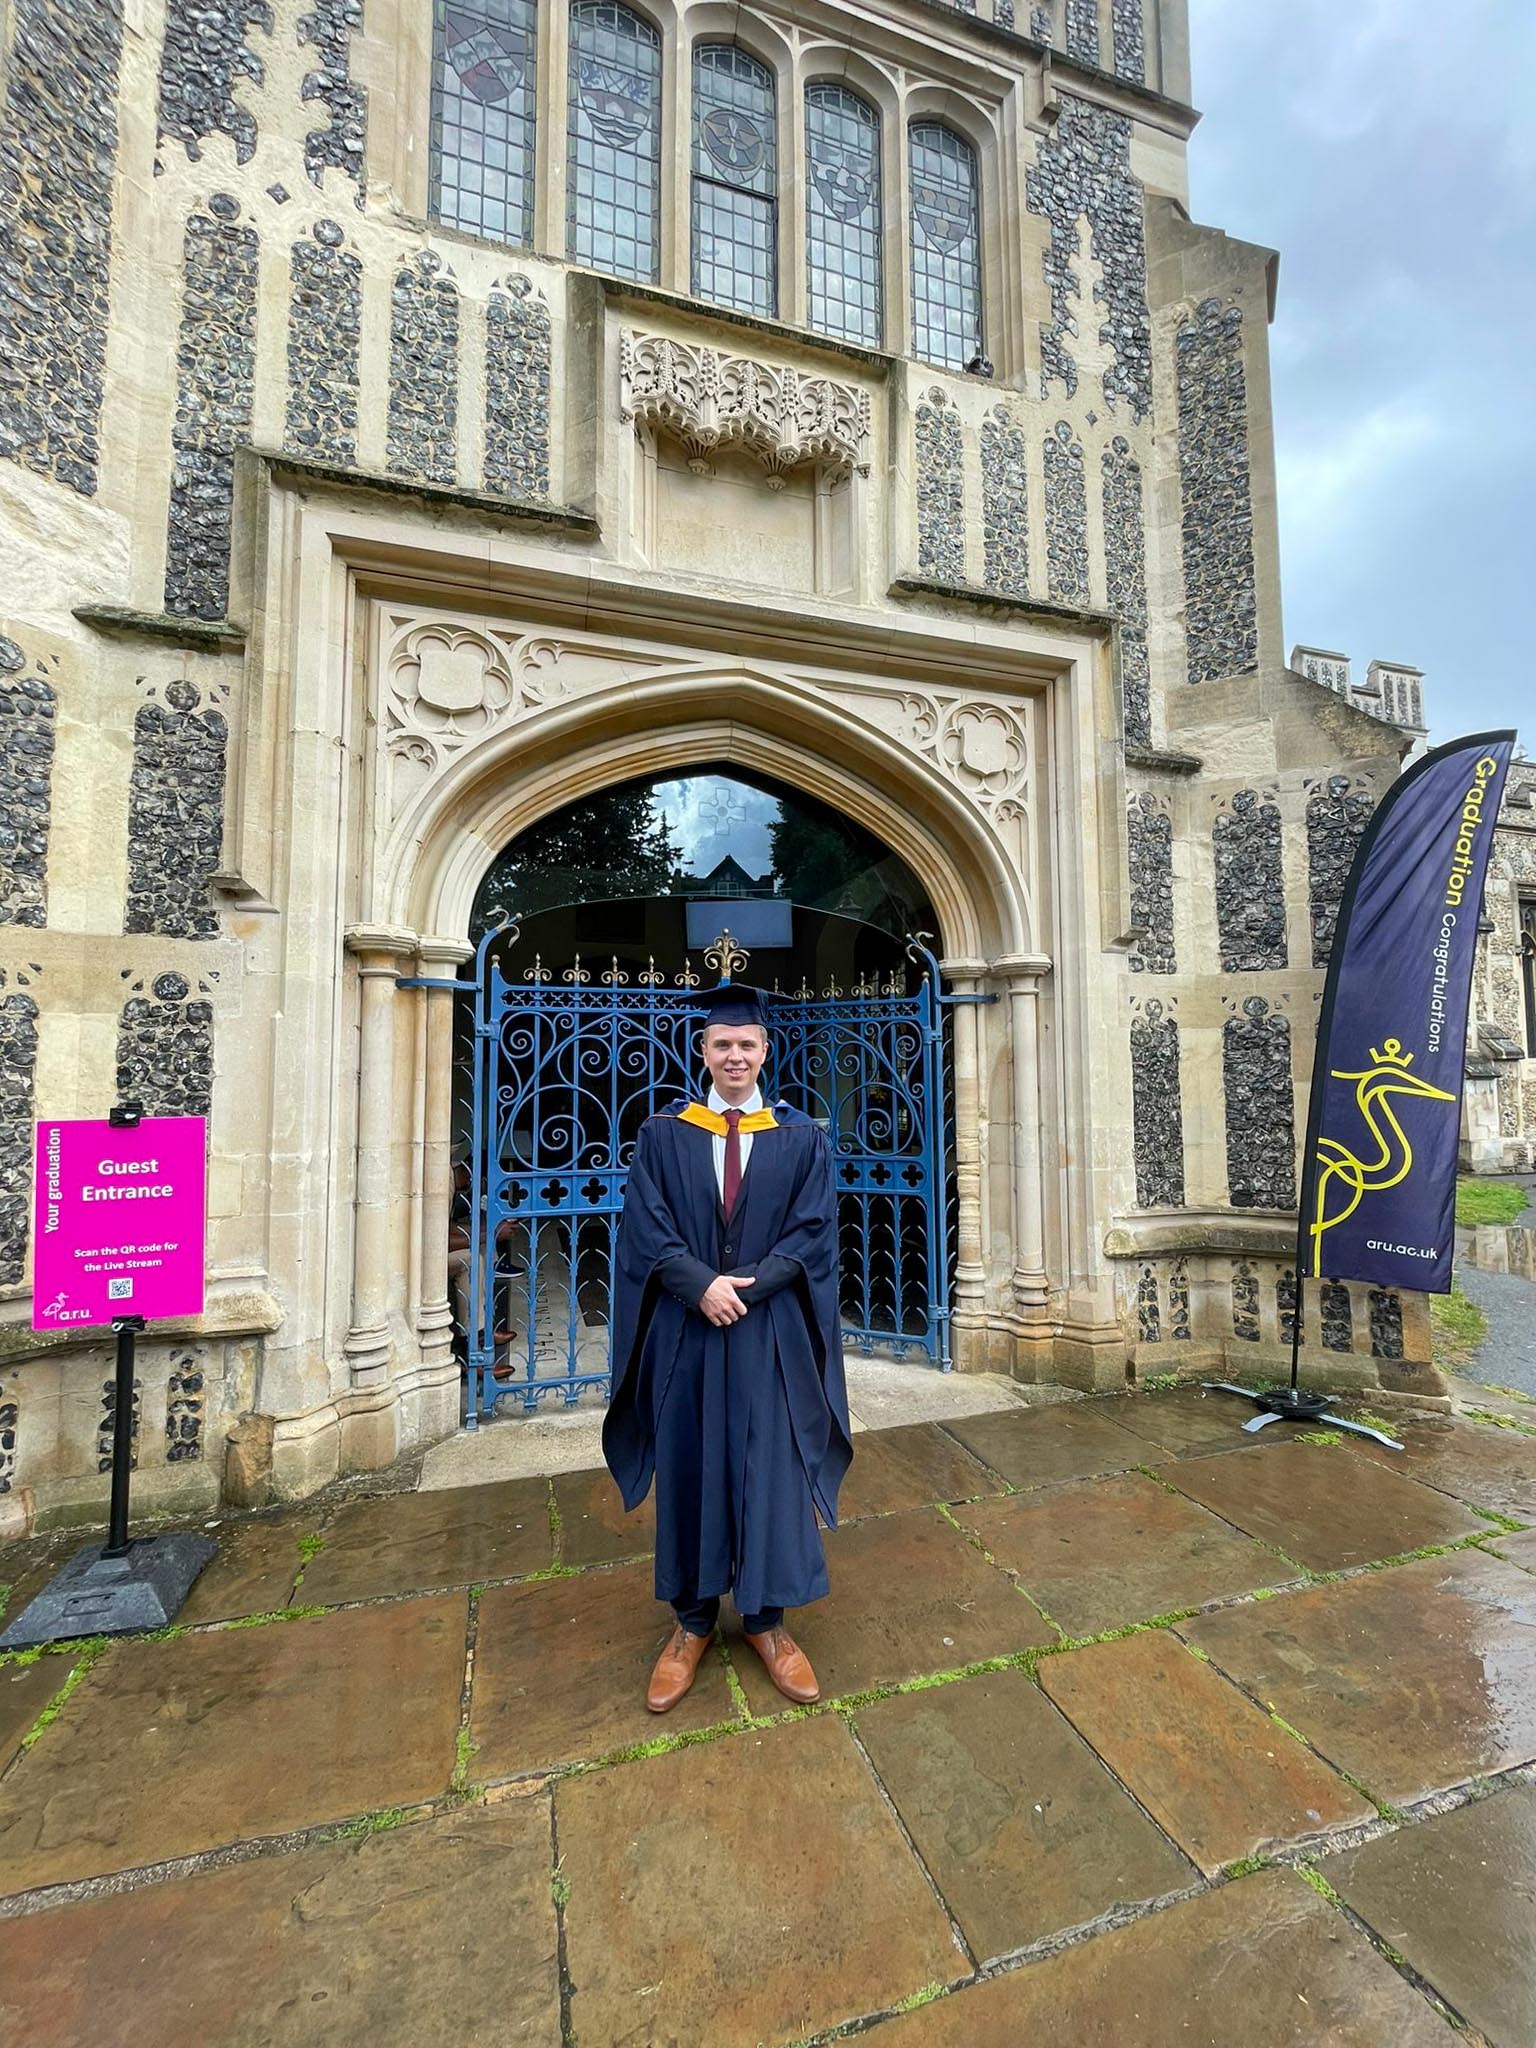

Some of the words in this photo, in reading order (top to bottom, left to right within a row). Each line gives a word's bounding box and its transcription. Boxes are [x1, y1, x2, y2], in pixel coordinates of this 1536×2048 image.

[1445, 756, 1497, 906] Graduation
[1428, 913, 1456, 1053] Congratulations
[45, 1128, 63, 1201] graduation
[98, 1159, 159, 1175] Guest
[81, 1184, 174, 1201] Entrance
[44, 1203, 60, 1234] Your
[74, 1248, 99, 1258] Scan
[101, 1246, 119, 1256] the
[120, 1245, 136, 1255] QR
[137, 1243, 162, 1253] code
[163, 1242, 179, 1252] for
[1366, 1239, 1438, 1260] aru.ac.uk
[84, 1262, 101, 1272] the
[103, 1261, 124, 1271] Live
[126, 1258, 162, 1269] Stream
